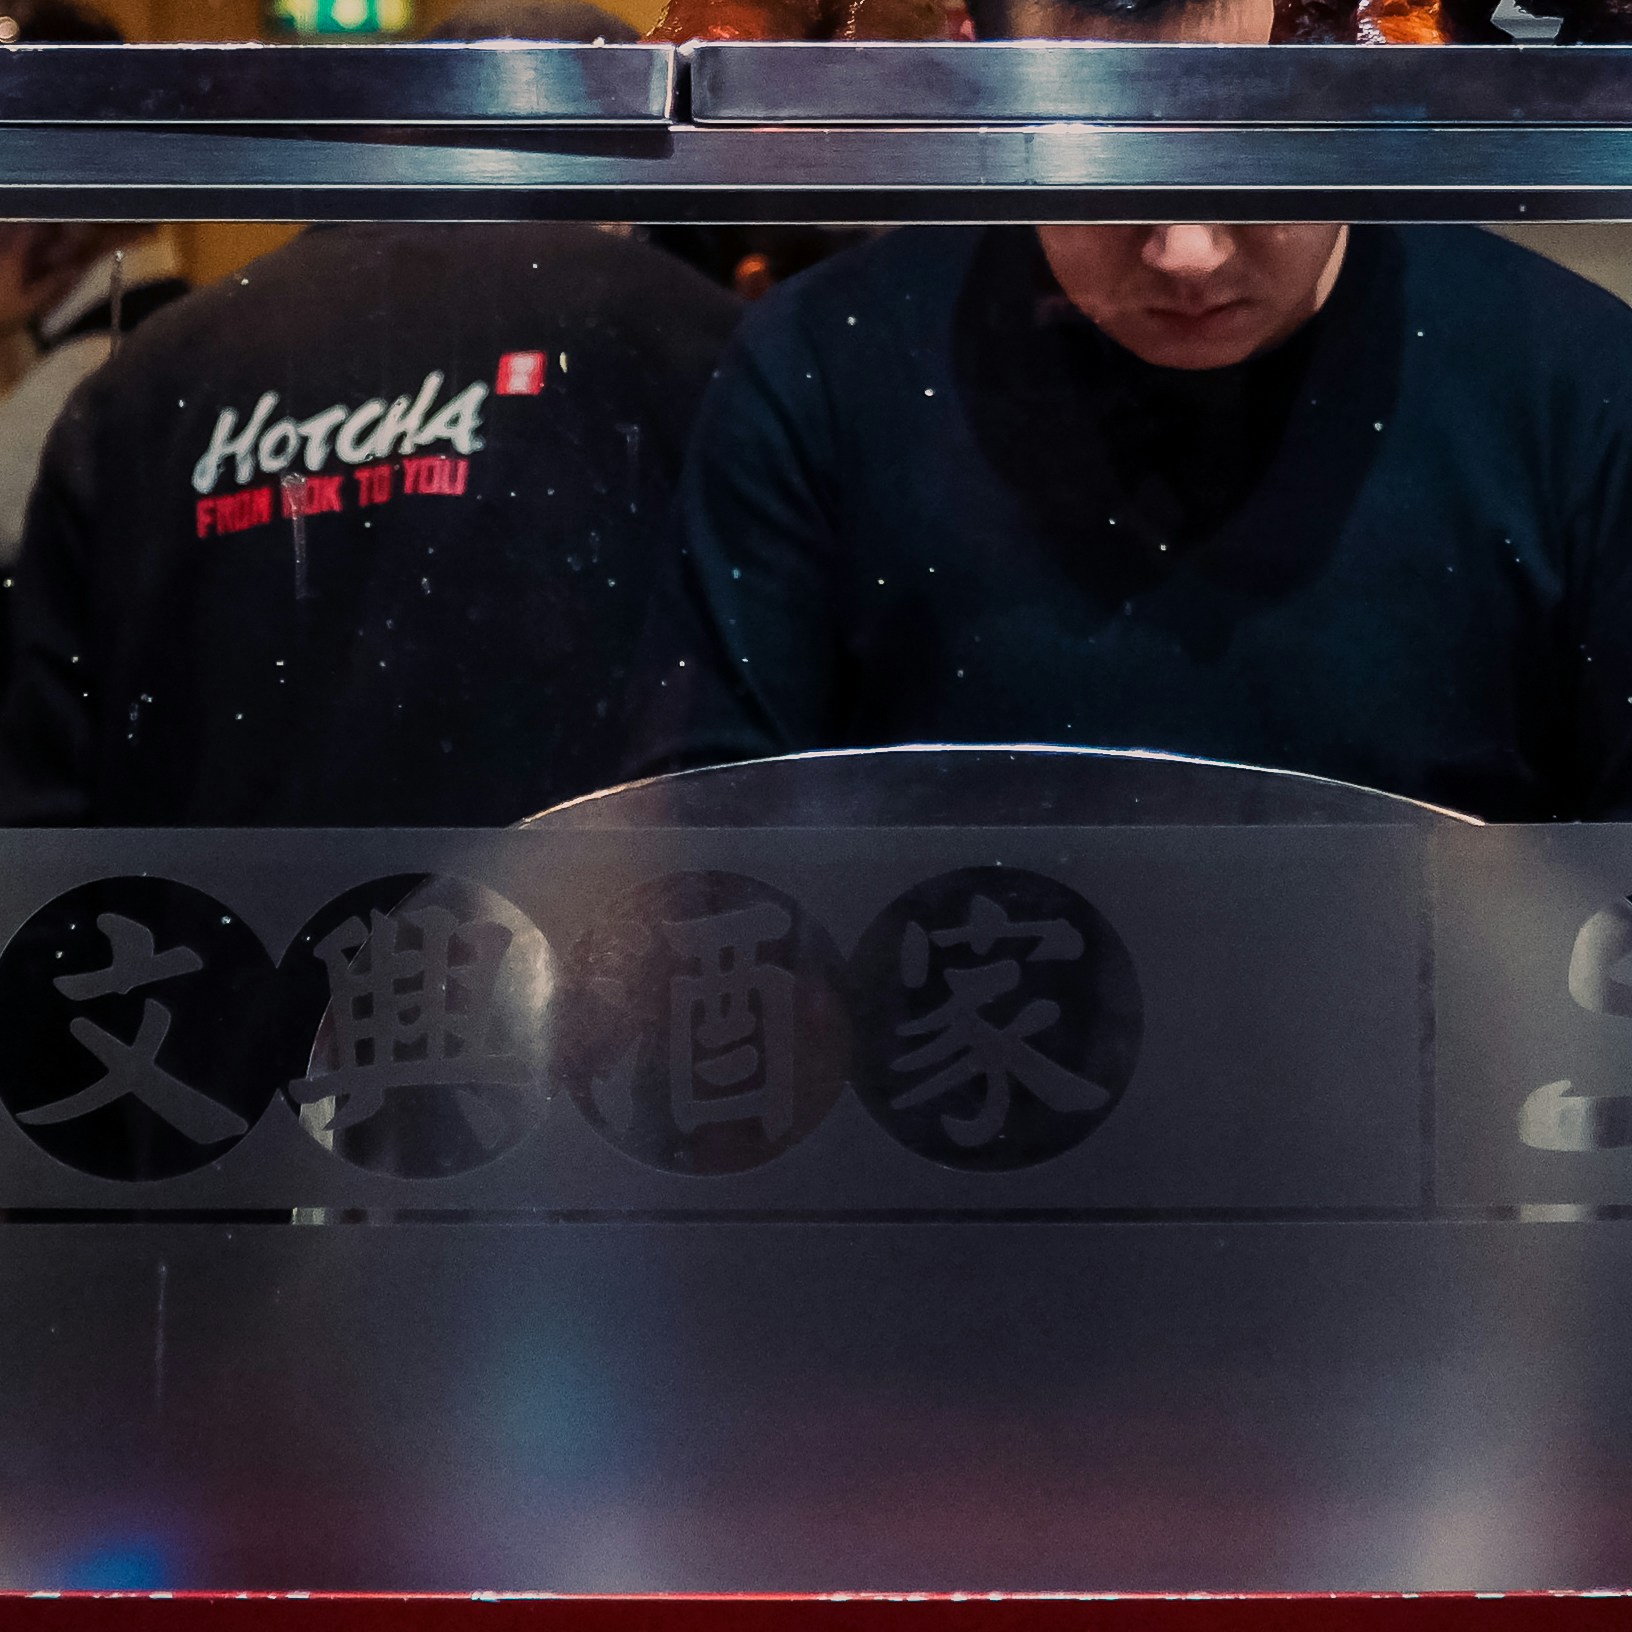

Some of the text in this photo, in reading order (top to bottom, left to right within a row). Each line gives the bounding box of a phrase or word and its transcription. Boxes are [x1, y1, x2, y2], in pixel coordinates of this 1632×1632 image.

[191, 370, 489, 494] HOTCHA
[354, 464, 392, 507] TO
[403, 456, 470, 496] YOU
